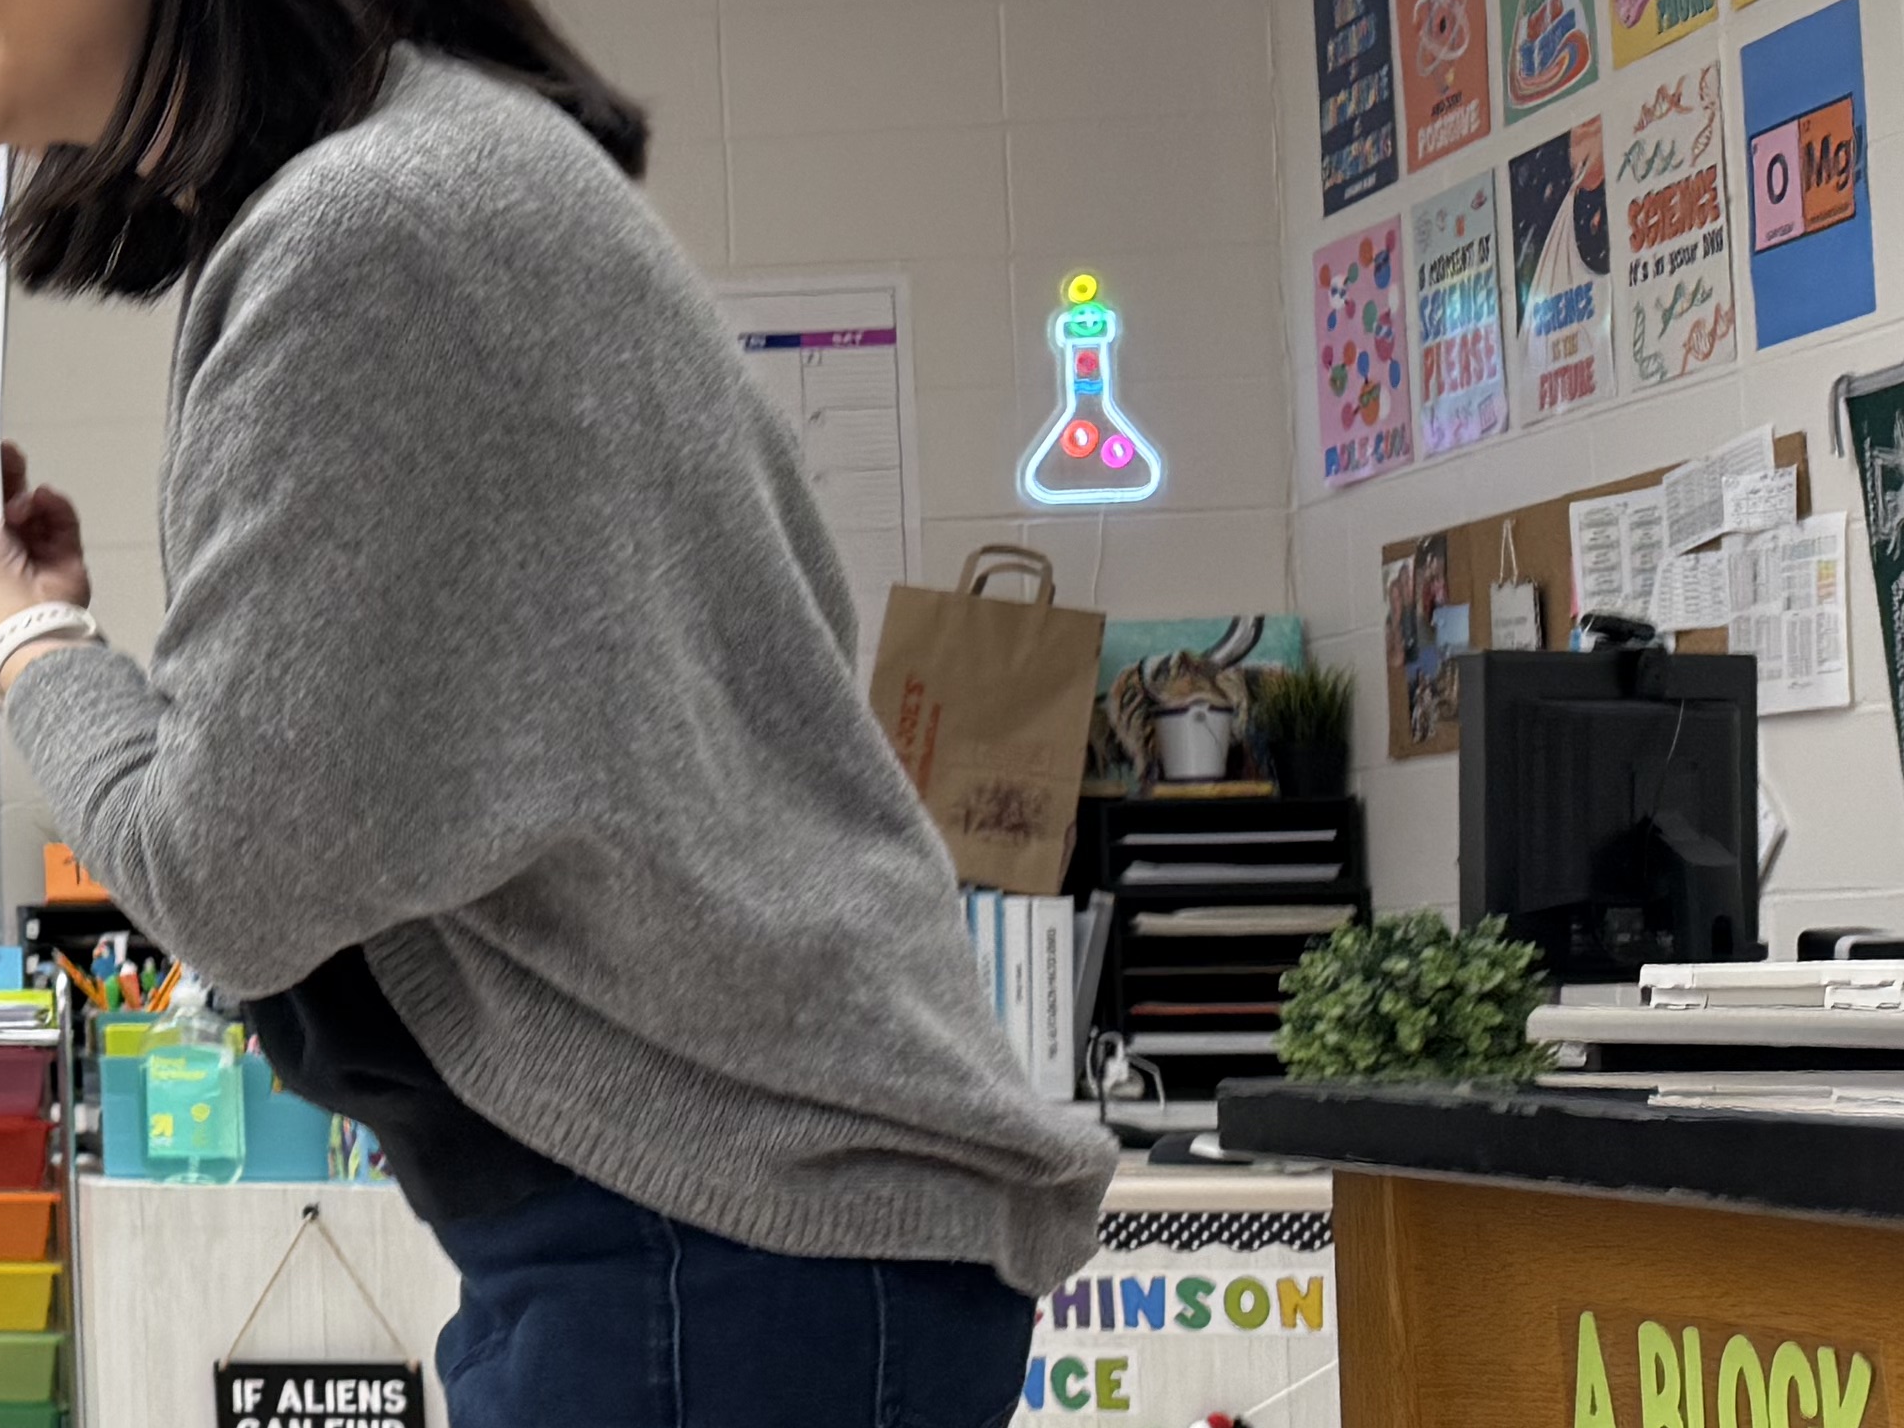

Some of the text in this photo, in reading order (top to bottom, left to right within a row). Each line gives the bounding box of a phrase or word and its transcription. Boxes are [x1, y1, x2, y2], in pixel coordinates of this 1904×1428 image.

[1418, 98, 1481, 161] POSITIVE
[1766, 152, 1789, 205] O
[1804, 133, 1854, 192] Mg
[1627, 163, 1722, 254] SCIENCE
[1668, 242, 1698, 276] your
[1703, 225, 1724, 260] DNA
[1419, 271, 1496, 344] SCIENCE
[1533, 280, 1595, 337] SCIENCE
[1422, 328, 1498, 405] PLEASE
[1539, 354, 1596, 412] FUTURE
[1050, 1275, 1324, 1331] HINSON
[232, 1378, 407, 1415] IF ALIENS
